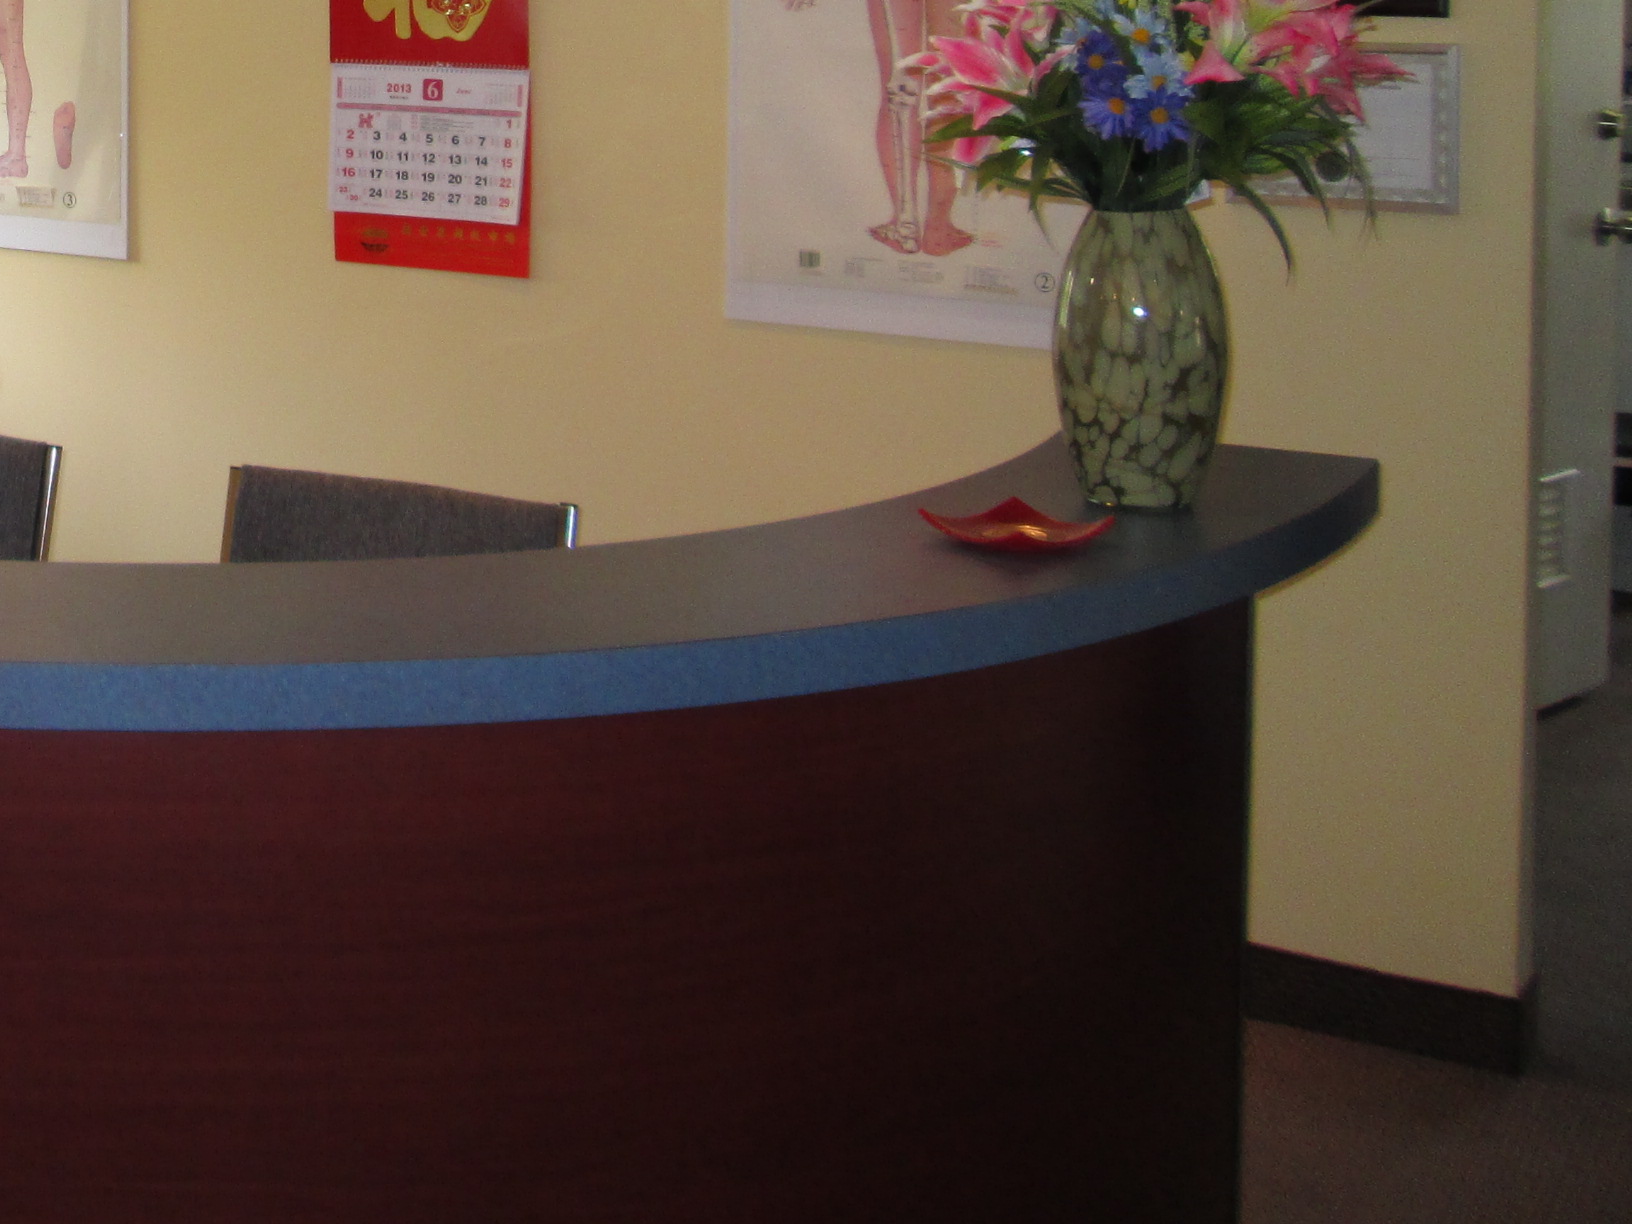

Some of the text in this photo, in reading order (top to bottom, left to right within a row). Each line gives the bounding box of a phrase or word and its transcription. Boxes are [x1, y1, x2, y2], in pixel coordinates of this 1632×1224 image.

[386, 82, 412, 94] 2013
[427, 81, 439, 100] 6
[346, 129, 511, 148] 2 3 4 5 6 7 8
[346, 148, 512, 168] 9 10 11 12 13 14 15
[342, 167, 511, 188] 16 17 18 19 20 21 22
[369, 188, 382, 198] 24
[395, 190, 408, 200] 25
[422, 191, 435, 201] 26
[448, 193, 461, 204] 27
[474, 195, 487, 205] 28
[499, 197, 510, 207] 29
